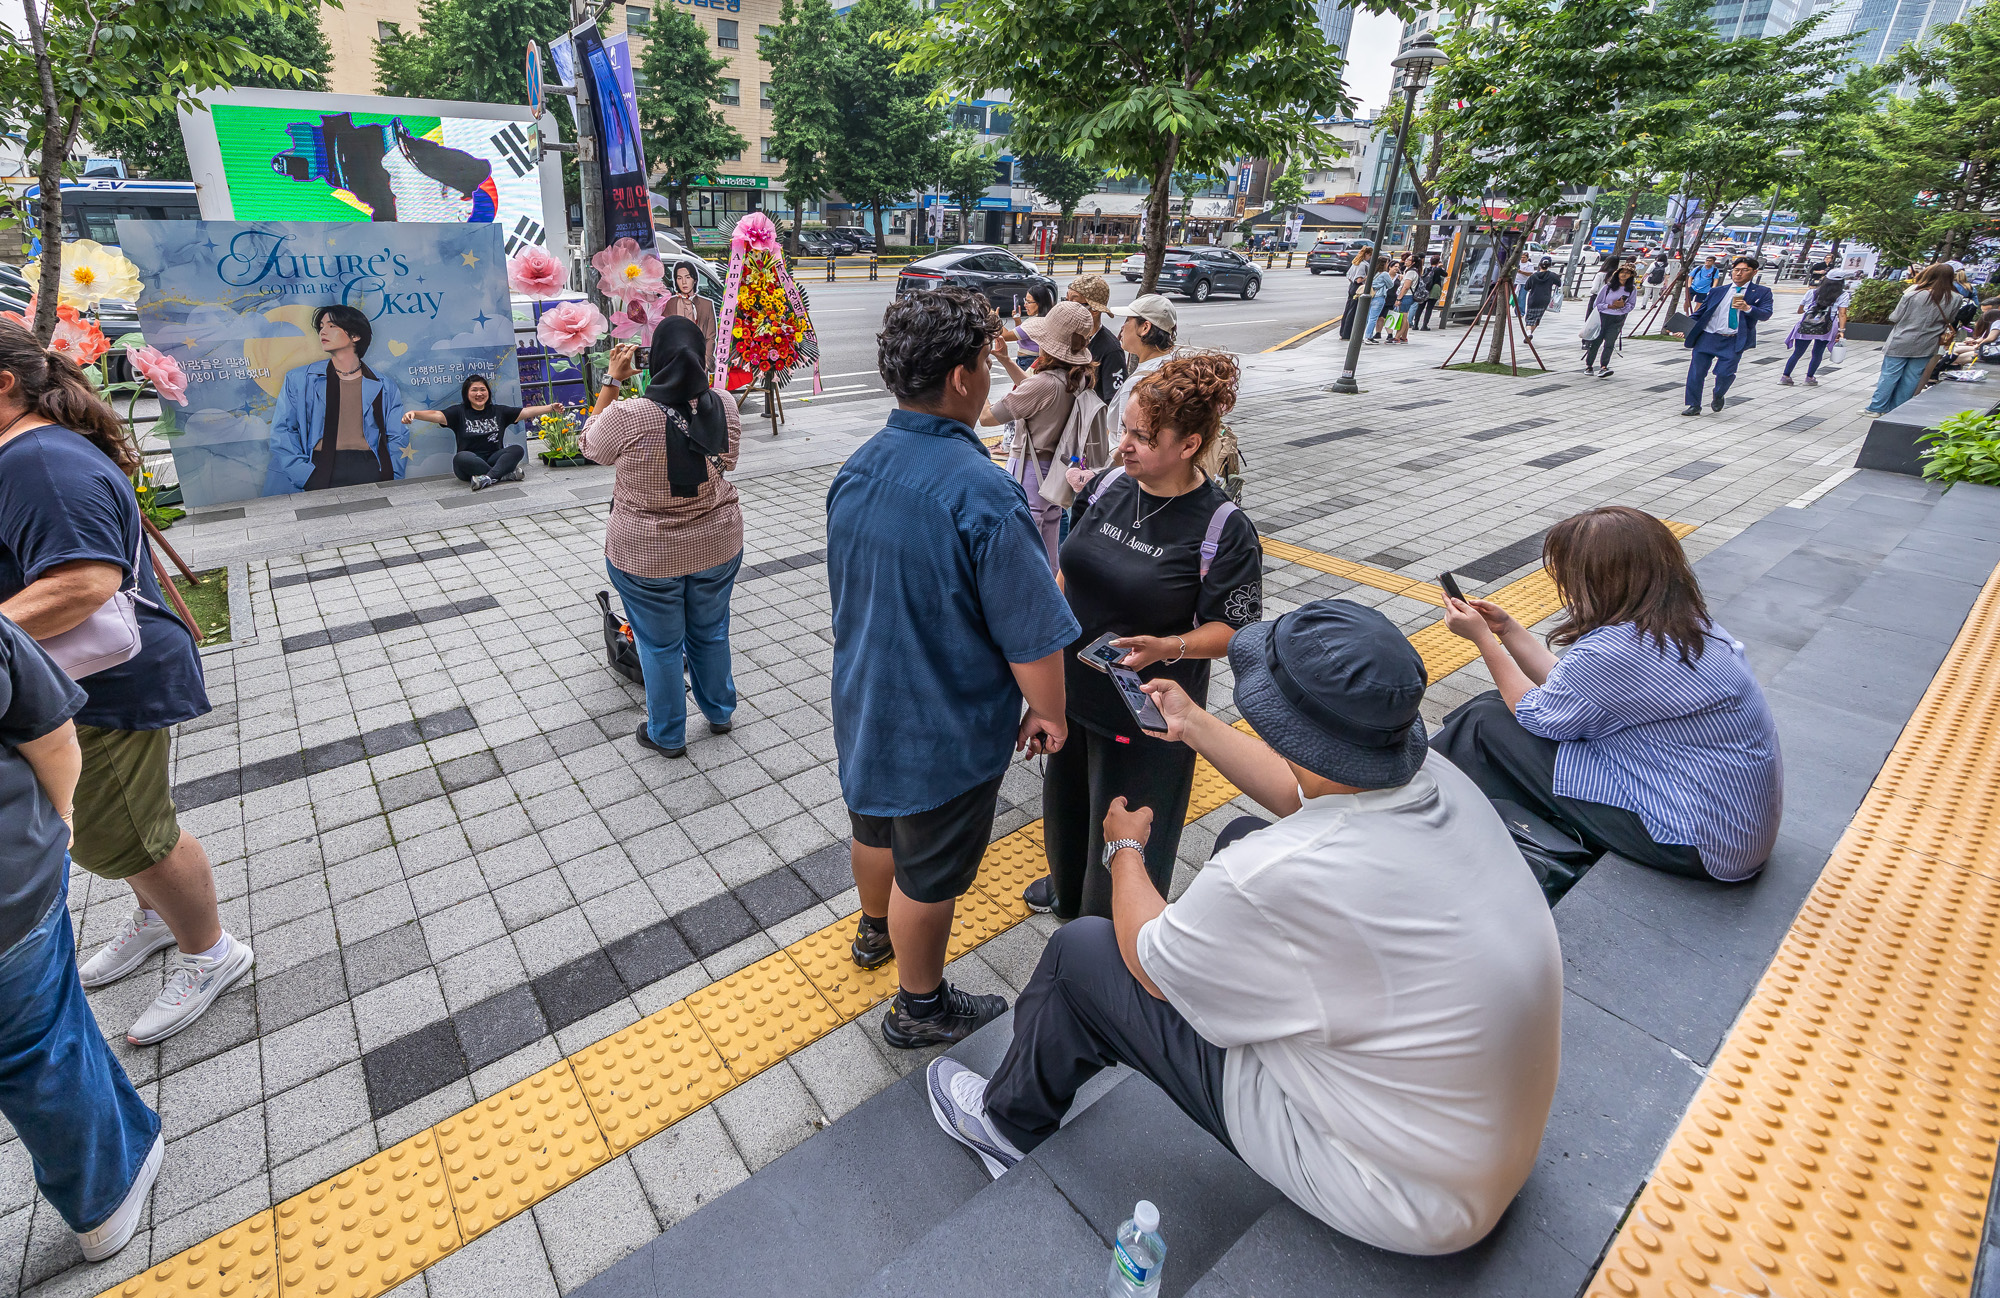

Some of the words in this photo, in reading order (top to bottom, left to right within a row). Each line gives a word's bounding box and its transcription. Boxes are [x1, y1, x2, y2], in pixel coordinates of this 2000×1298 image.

[95, 181, 125, 190] EV
[225, 356, 252, 368] 말해
[408, 364, 446, 376] 다행히도
[448, 362, 466, 373] 우리
[468, 361, 496, 371] 사이는
[218, 370, 231, 380] 다
[410, 375, 432, 387] 아직
[433, 374, 453, 385] 여태
[1100, 522, 1122, 542] SUGA
[1126, 535, 1155, 555] Agust
[1152, 546, 1164, 559] D
